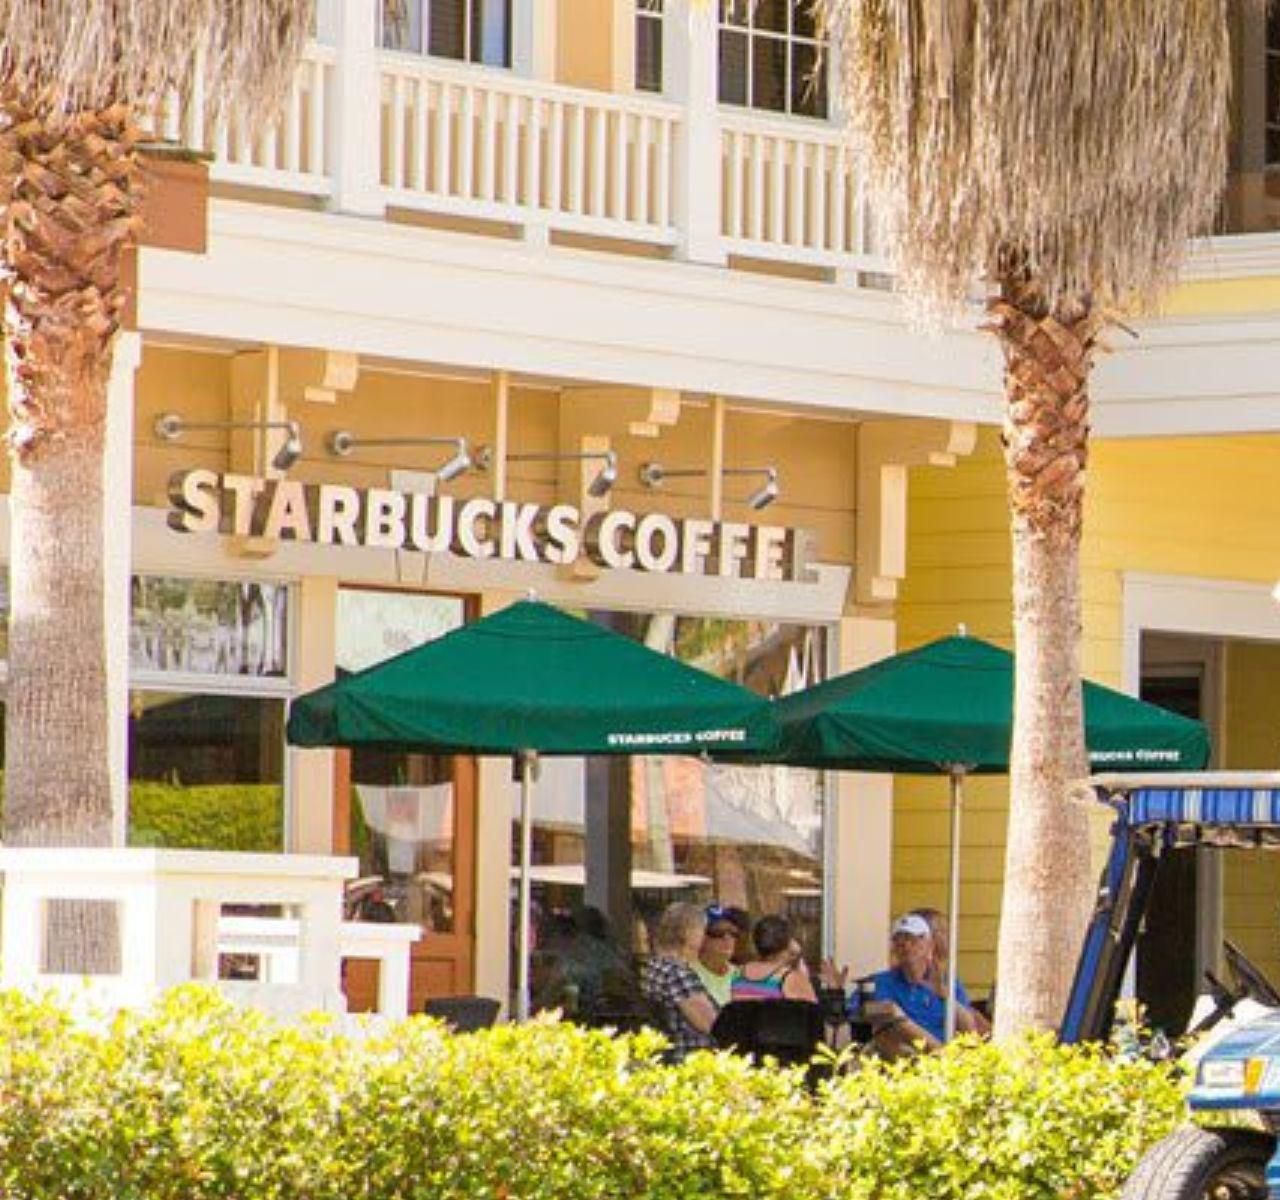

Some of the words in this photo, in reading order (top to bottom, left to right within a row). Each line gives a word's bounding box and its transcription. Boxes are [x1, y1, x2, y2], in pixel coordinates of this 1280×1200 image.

[168, 468, 581, 566] STARBUCKS
[590, 509, 819, 583] COFFEE
[607, 733, 693, 744] STARBUCKS
